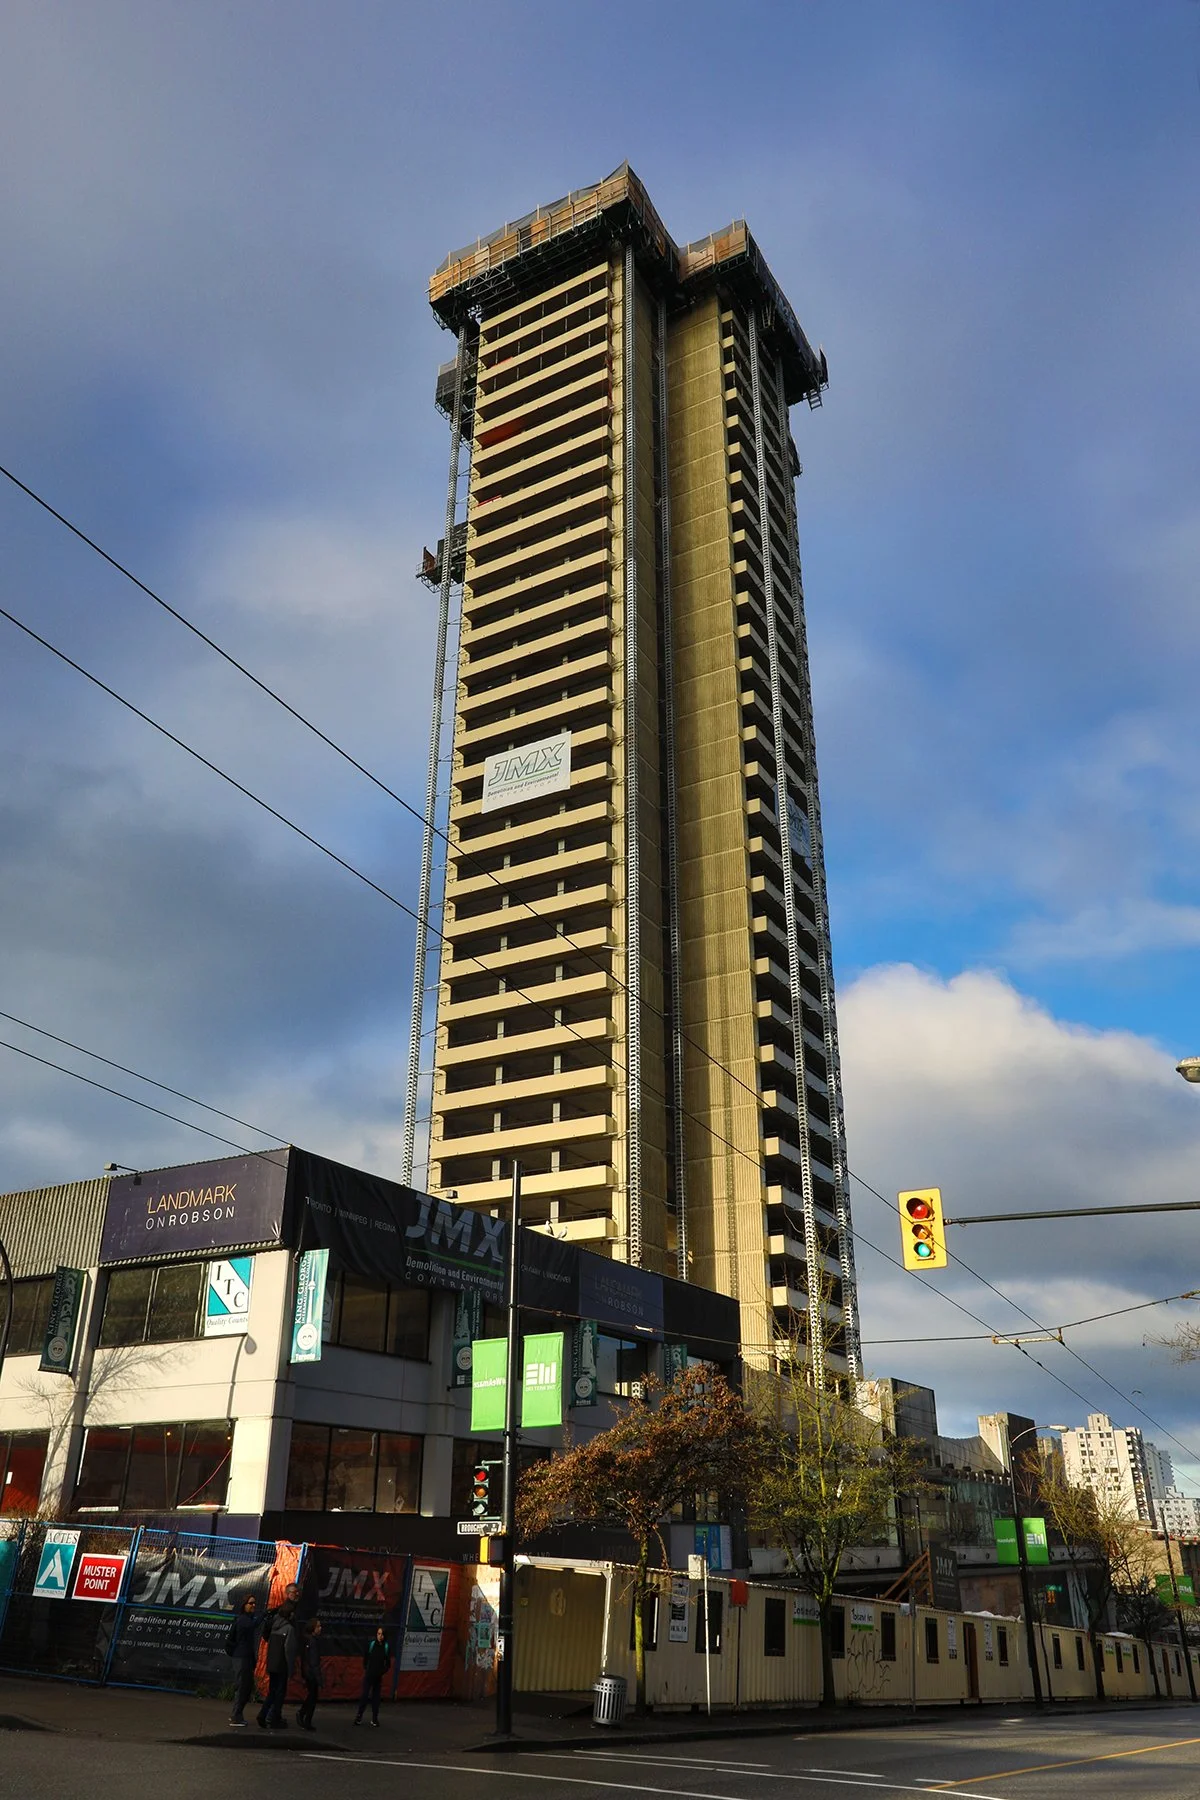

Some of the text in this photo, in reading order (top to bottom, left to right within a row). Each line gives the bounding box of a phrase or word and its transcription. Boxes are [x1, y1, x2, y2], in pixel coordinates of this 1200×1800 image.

[488, 742, 566, 787] JMX
[147, 1183, 237, 1214] LANDMARK
[374, 1220, 396, 1233] REGINA
[405, 1192, 506, 1264] JMX
[448, 1268, 460, 1279] and
[294, 1298, 304, 1324] KING
[47, 1310, 57, 1335] KING
[206, 1316, 226, 1328] Quality
[46, 1532, 79, 1544] ACTES
[83, 1565, 117, 1578] MUSTER
[936, 1556, 955, 1577] JMX
[83, 1578, 110, 1591] POINT
[132, 1570, 243, 1611] JMX
[318, 1566, 391, 1601] JMX
[126, 1624, 230, 1640] CONTRACTORS
[129, 1614, 232, 1631] Demolition and Environmental
